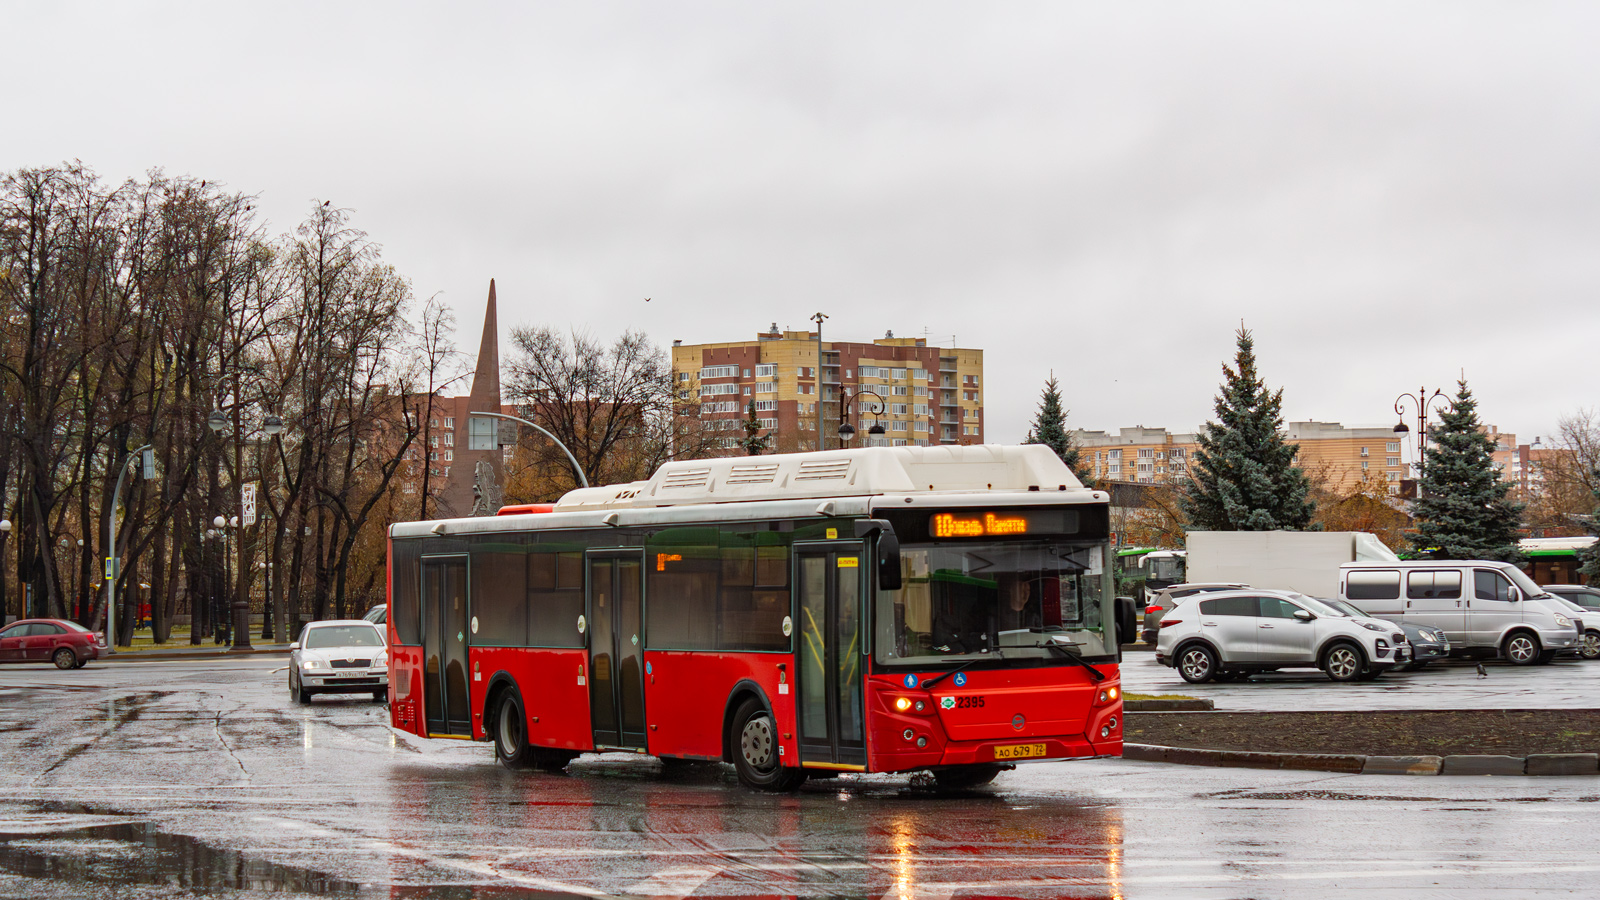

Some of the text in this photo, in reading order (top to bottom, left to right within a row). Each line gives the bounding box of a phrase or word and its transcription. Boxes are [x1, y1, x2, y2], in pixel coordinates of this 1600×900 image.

[957, 696, 985, 708] 2395
[1013, 746, 1030, 757] 679
[1034, 744, 1043, 752] 72
